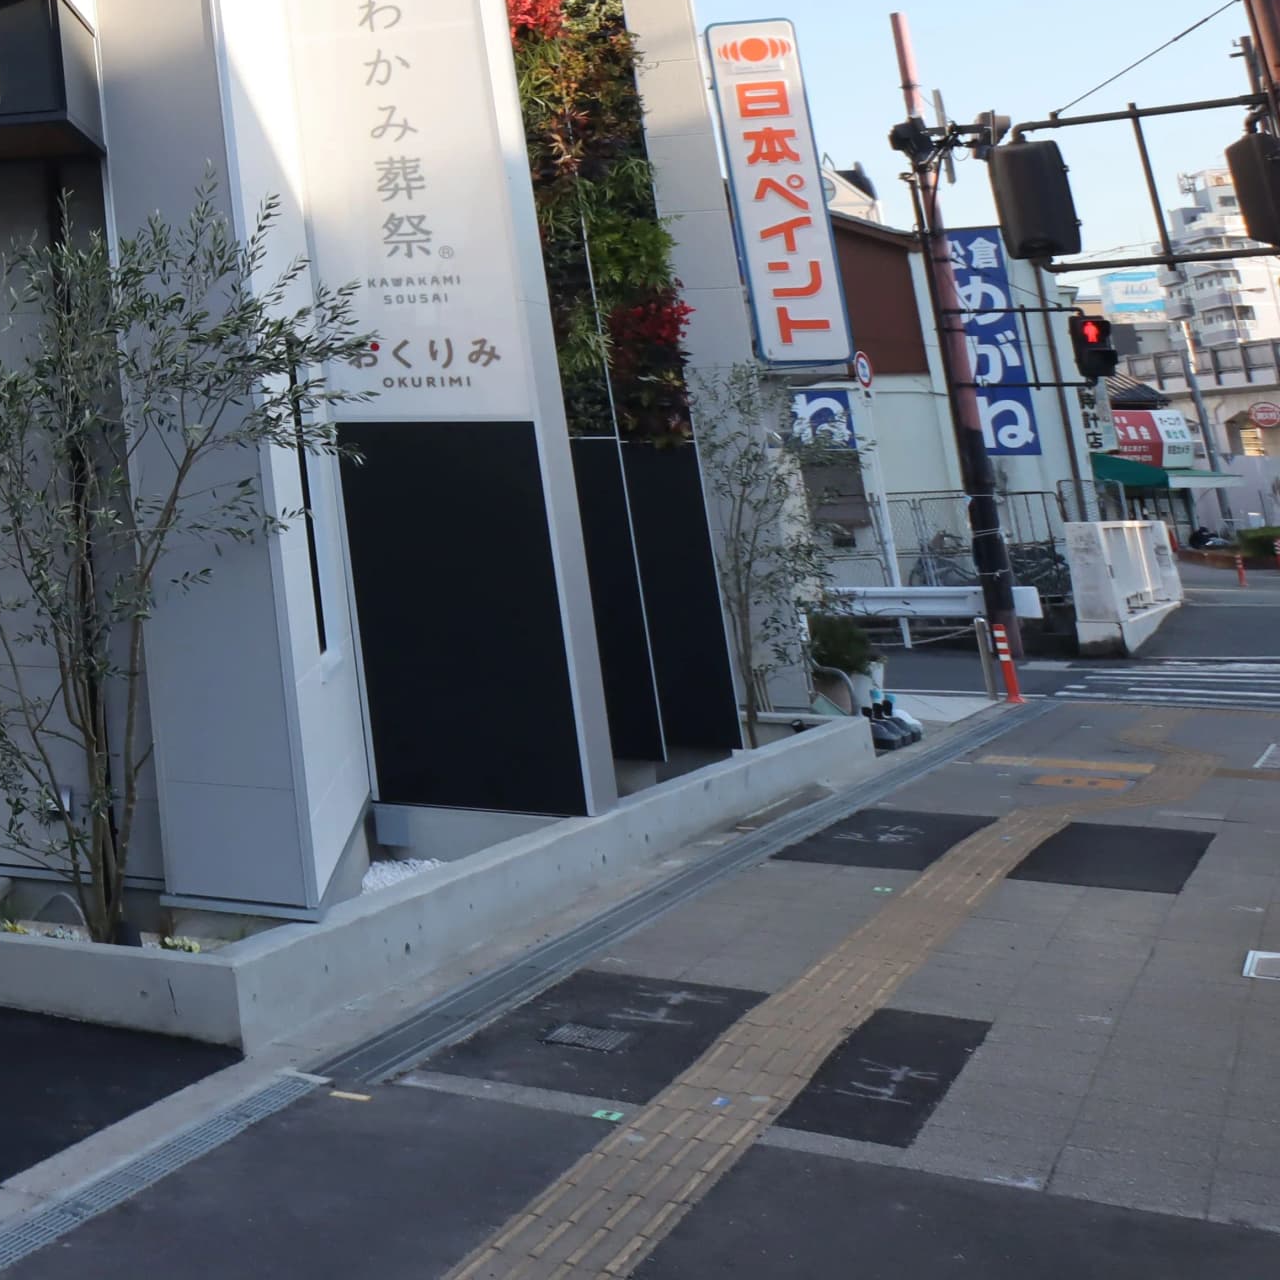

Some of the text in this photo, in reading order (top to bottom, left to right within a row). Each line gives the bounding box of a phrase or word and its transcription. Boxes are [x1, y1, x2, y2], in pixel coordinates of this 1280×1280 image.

[735, 80, 832, 345] 日本ペイント
[367, 275, 461, 289] KAWAKAMI
[384, 293, 449, 305] SOUSAI
[382, 375, 472, 389] OKURIMI
